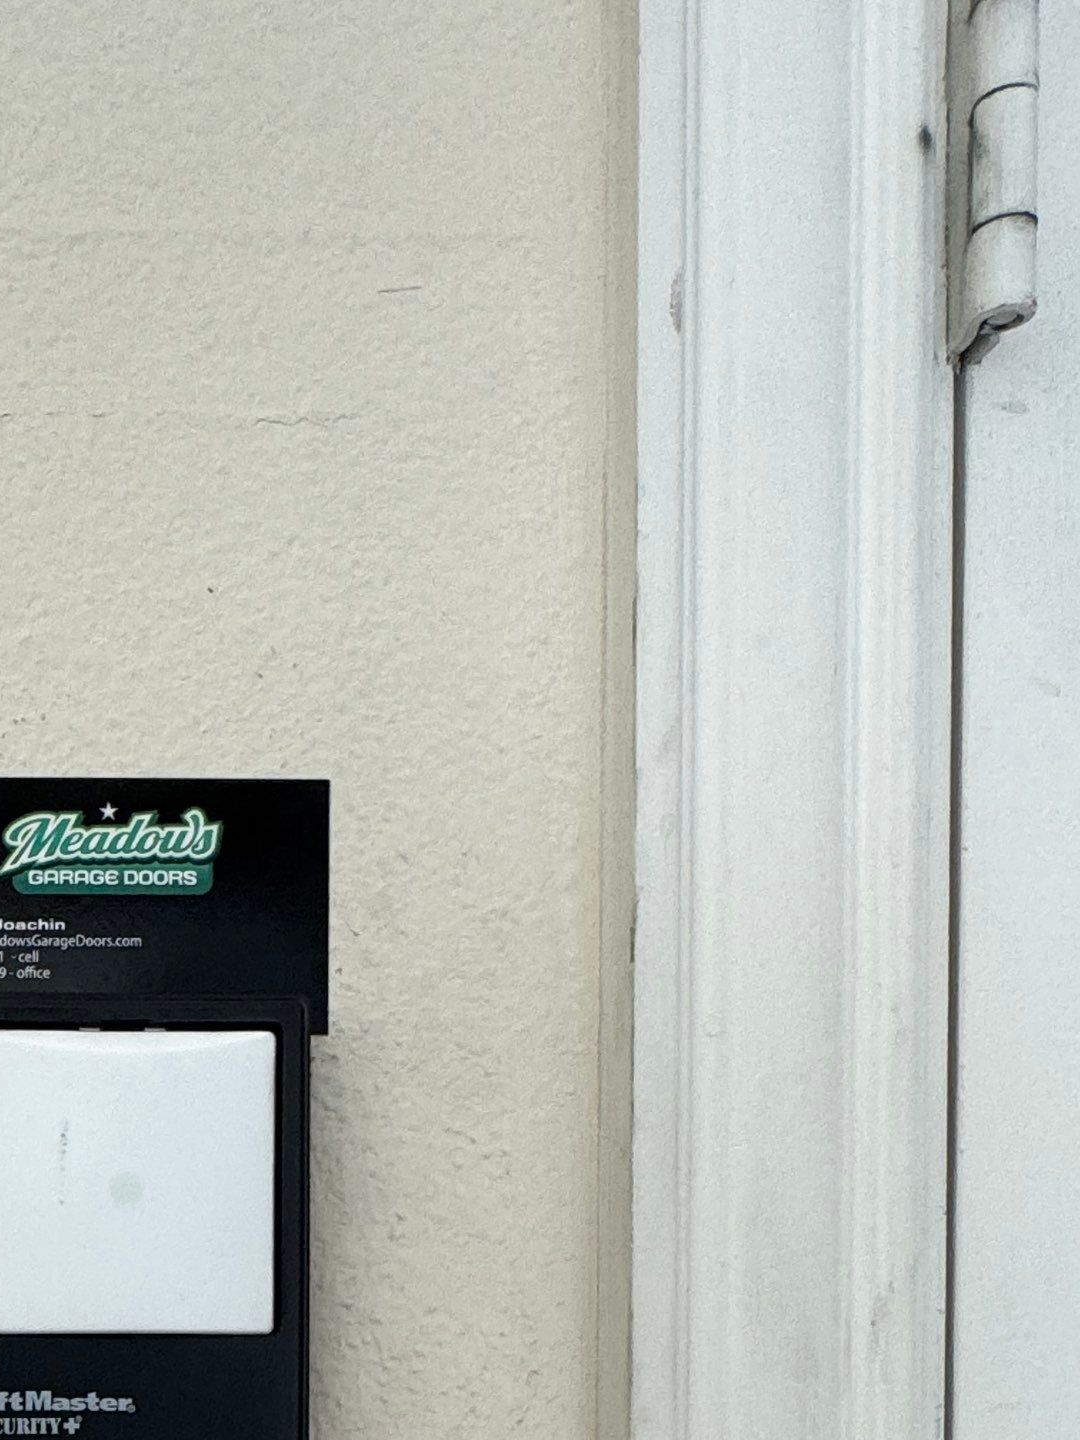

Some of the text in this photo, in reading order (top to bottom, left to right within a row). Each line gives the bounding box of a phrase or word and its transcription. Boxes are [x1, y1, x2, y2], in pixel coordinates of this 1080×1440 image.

[27, 869, 198, 887] GARAGE DOORS
[18, 950, 39, 963] cell
[16, 966, 51, 980] office
